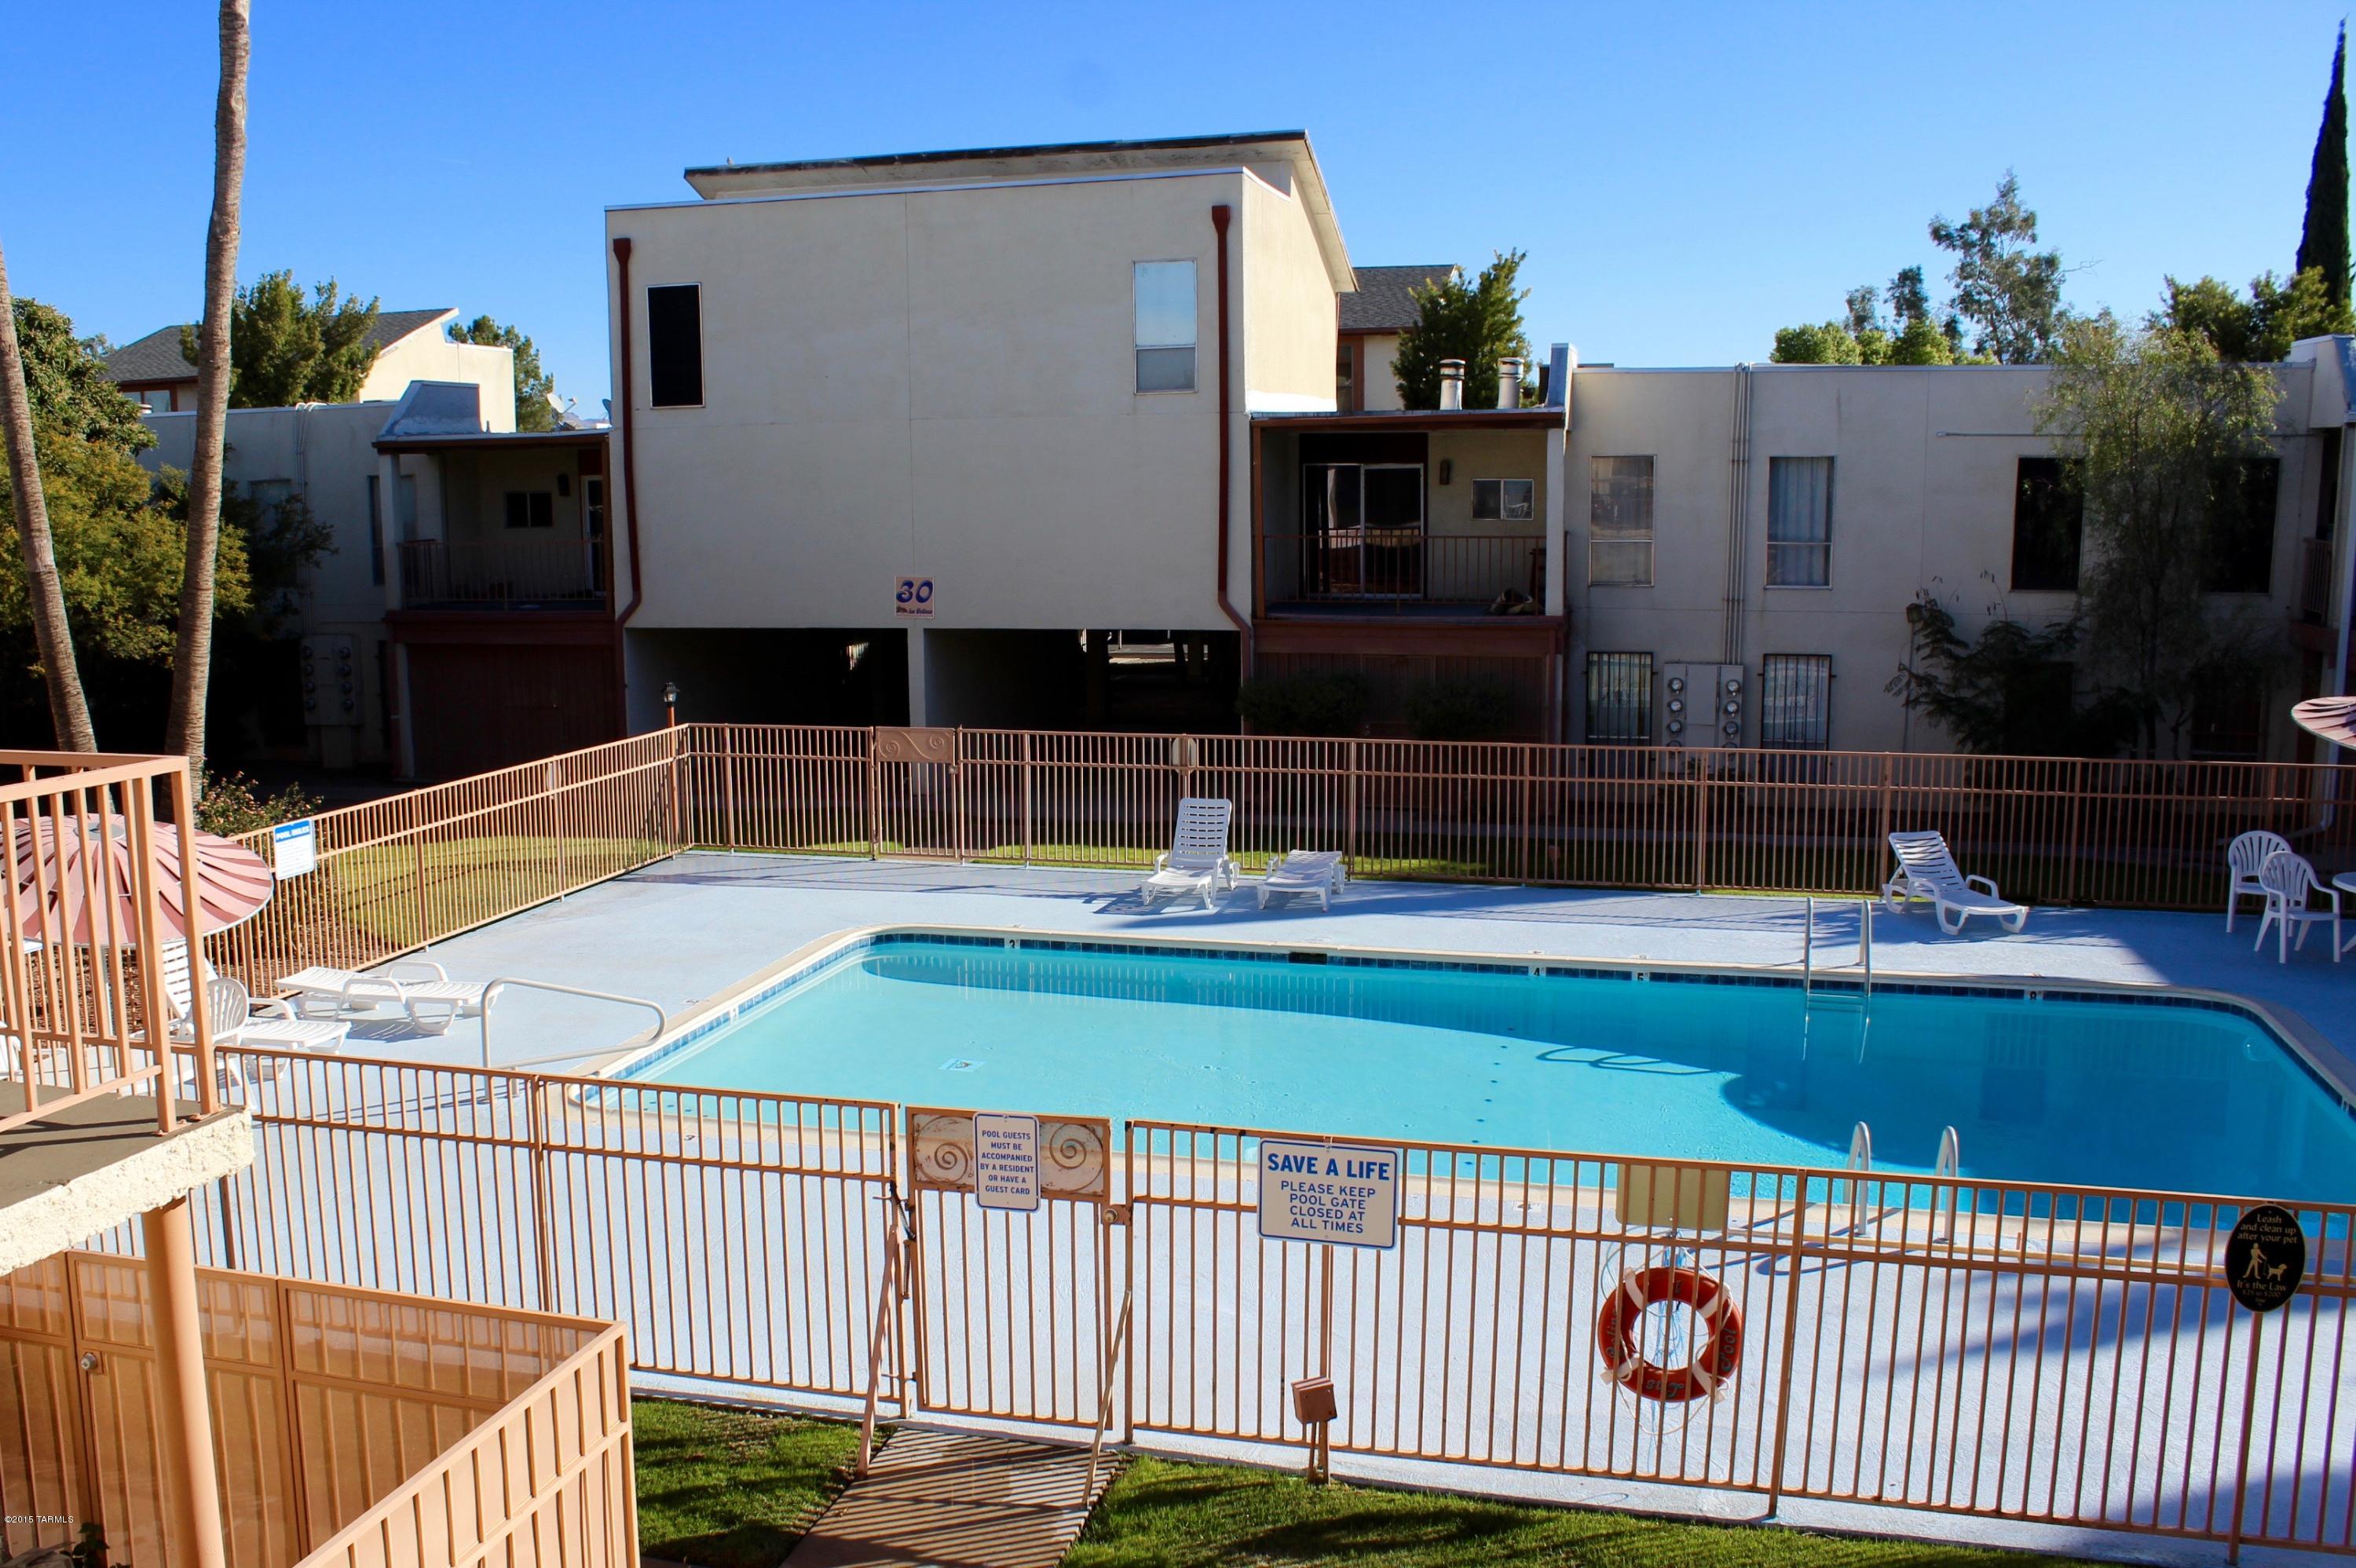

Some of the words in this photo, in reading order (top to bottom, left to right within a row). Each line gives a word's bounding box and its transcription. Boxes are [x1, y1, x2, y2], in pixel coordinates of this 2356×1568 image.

[896, 579, 934, 604] 30
[1003, 1131, 1031, 1140] GUESTS
[982, 1152, 1033, 1162] ACCOMPANIED
[999, 1164, 1034, 1173] RESIDENT
[1268, 1153, 1318, 1175] SAVE
[1326, 1158, 1339, 1176] A
[1347, 1160, 1390, 1181] LIFE
[985, 1185, 1008, 1193] GUEST
[1011, 1186, 1030, 1195] CARD
[1281, 1180, 1334, 1195] PLEASE
[1339, 1186, 1375, 1198] KEEP
[1290, 1193, 1326, 1206] POOL
[1330, 1197, 1366, 1210] GATE
[1290, 1205, 1344, 1219] CLOSED
[1348, 1212, 1366, 1222] AT
[2257, 1213, 2281, 1224] Leash
[1291, 1217, 1317, 1229] ALL
[1322, 1219, 1363, 1234] TIMES
[2259, 1223, 2282, 1233] clean
[2285, 1227, 2297, 1236] up
[2237, 1231, 2258, 1241] after
[2261, 1234, 2281, 1243] your
[2283, 1235, 2298, 1245] pet
[2237, 1279, 2250, 1288] It's
[2252, 1281, 2267, 1290] the
[2270, 1282, 2288, 1292] Law
